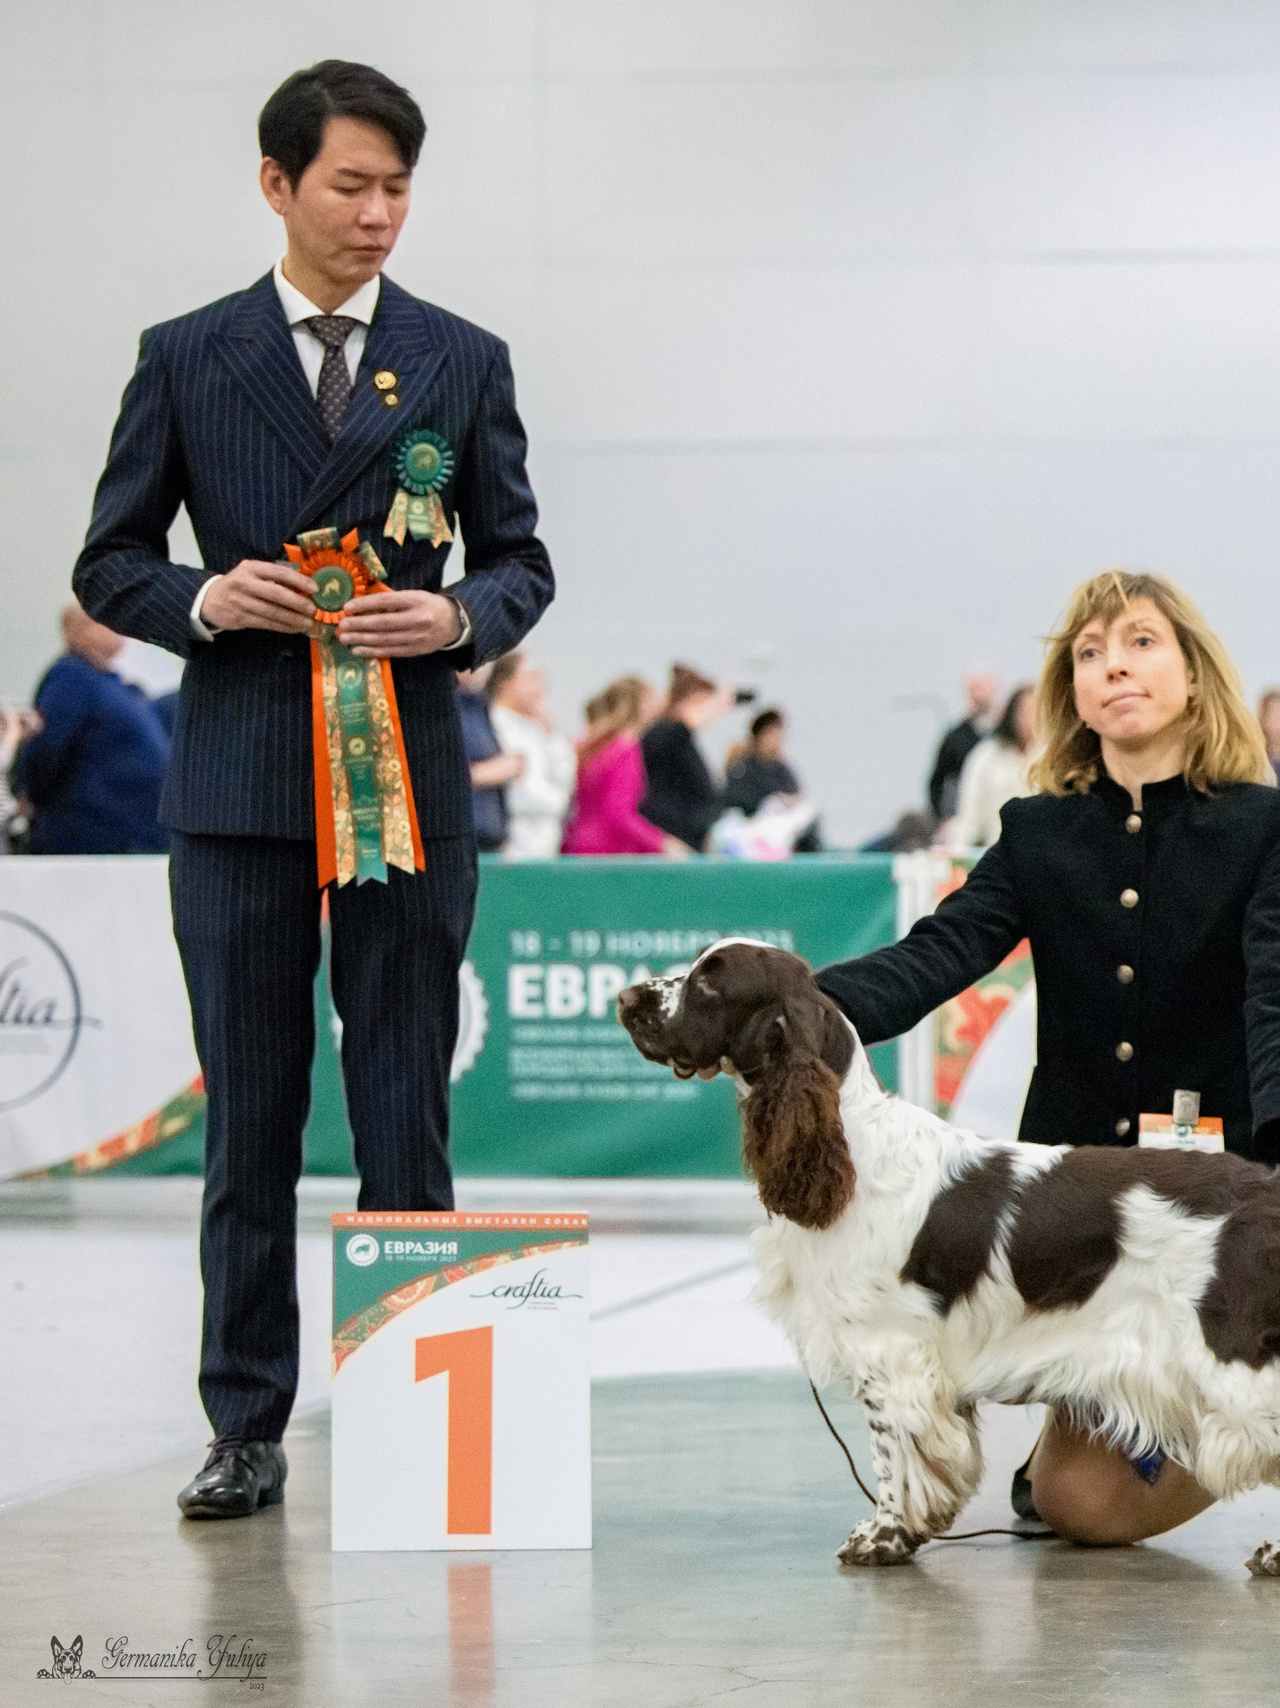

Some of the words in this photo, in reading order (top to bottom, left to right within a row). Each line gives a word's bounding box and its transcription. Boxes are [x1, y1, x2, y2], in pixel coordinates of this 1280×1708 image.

[347, 1215, 458, 1225] НАЦИОНАЛЬНЫЕ
[465, 1216, 537, 1225] ВЫСТАВКИ
[544, 1217, 588, 1226] СОБАК
[384, 1241, 458, 1255] ЕВРАЗИЯ
[470, 1268, 583, 1309] craftia
[415, 1325, 493, 1534] 1
